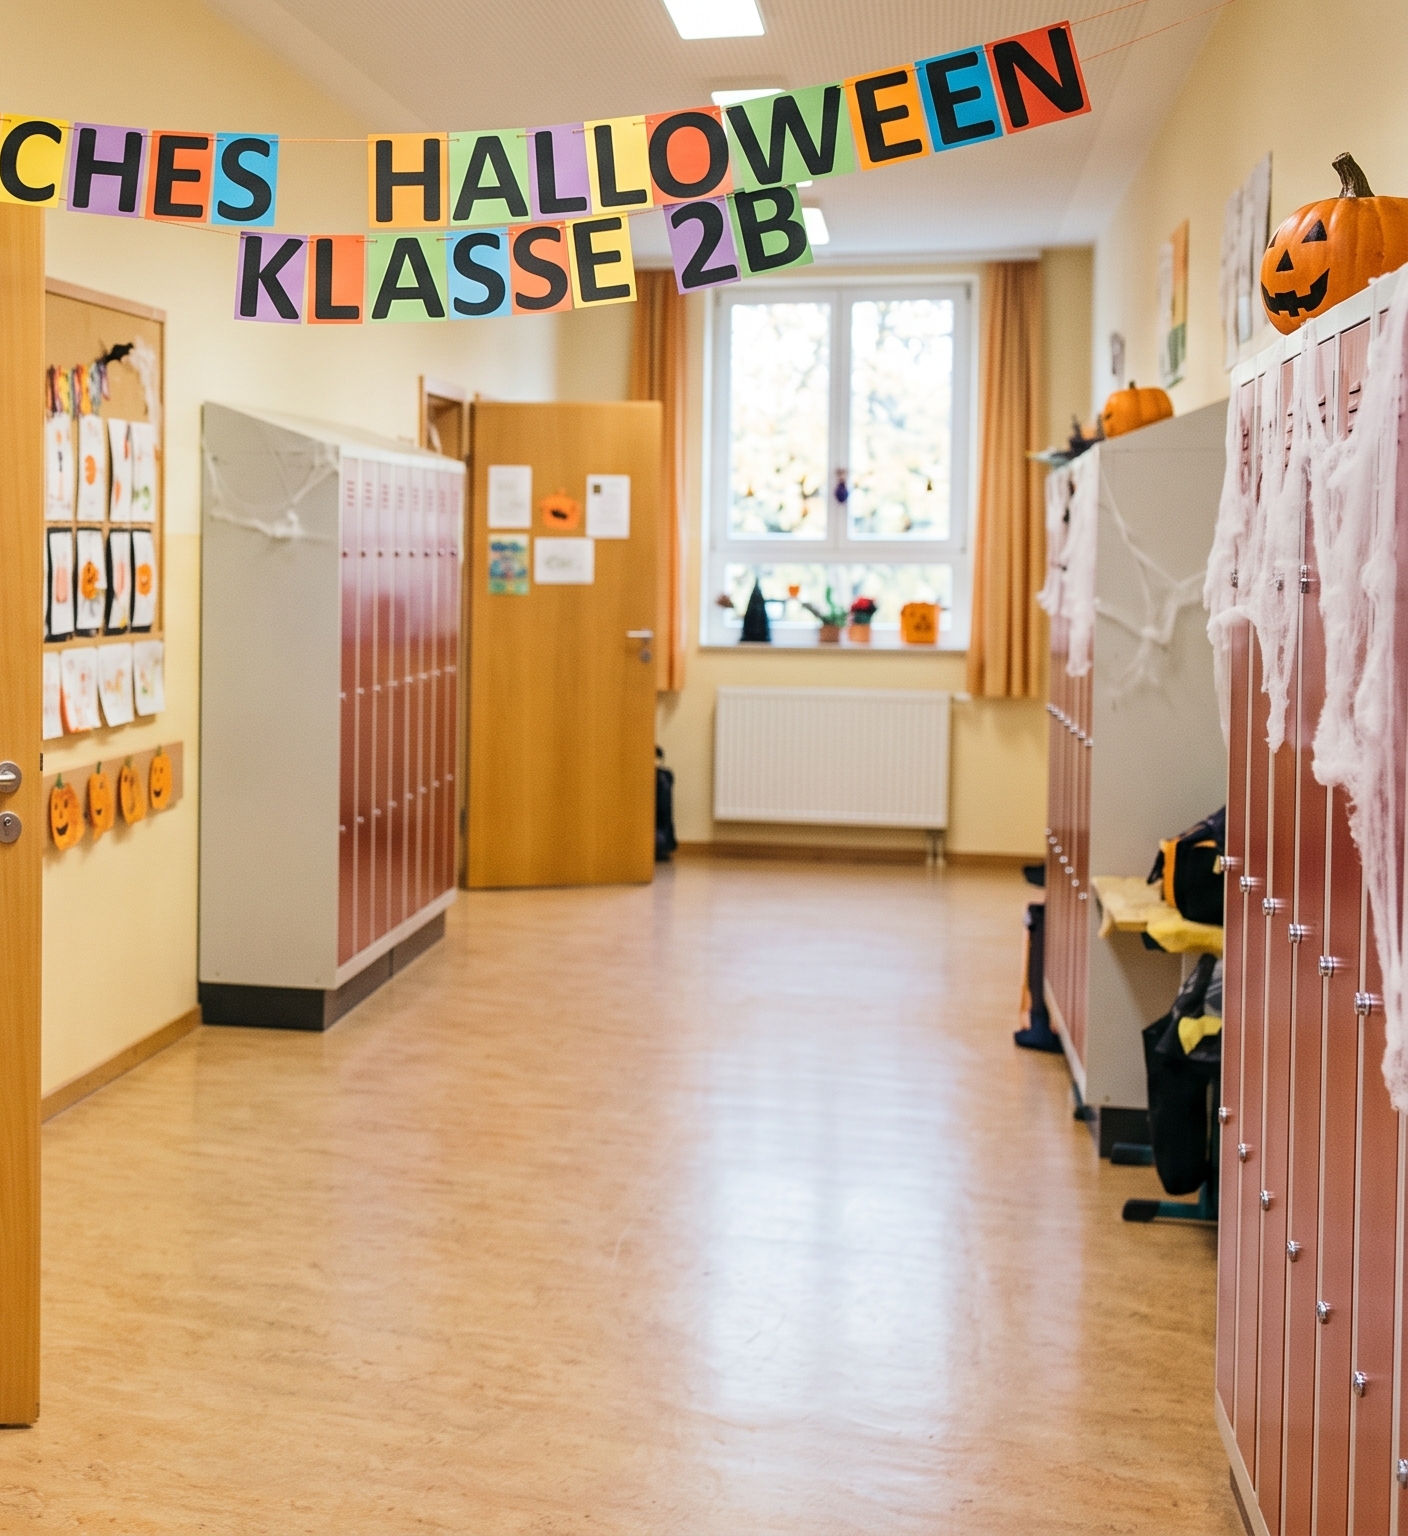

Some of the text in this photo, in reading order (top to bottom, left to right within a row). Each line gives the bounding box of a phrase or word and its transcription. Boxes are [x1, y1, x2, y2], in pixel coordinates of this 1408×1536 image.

[376, 27, 1084, 221] HALLOWEEN
[240, 186, 808, 320] KLASSE 2B
